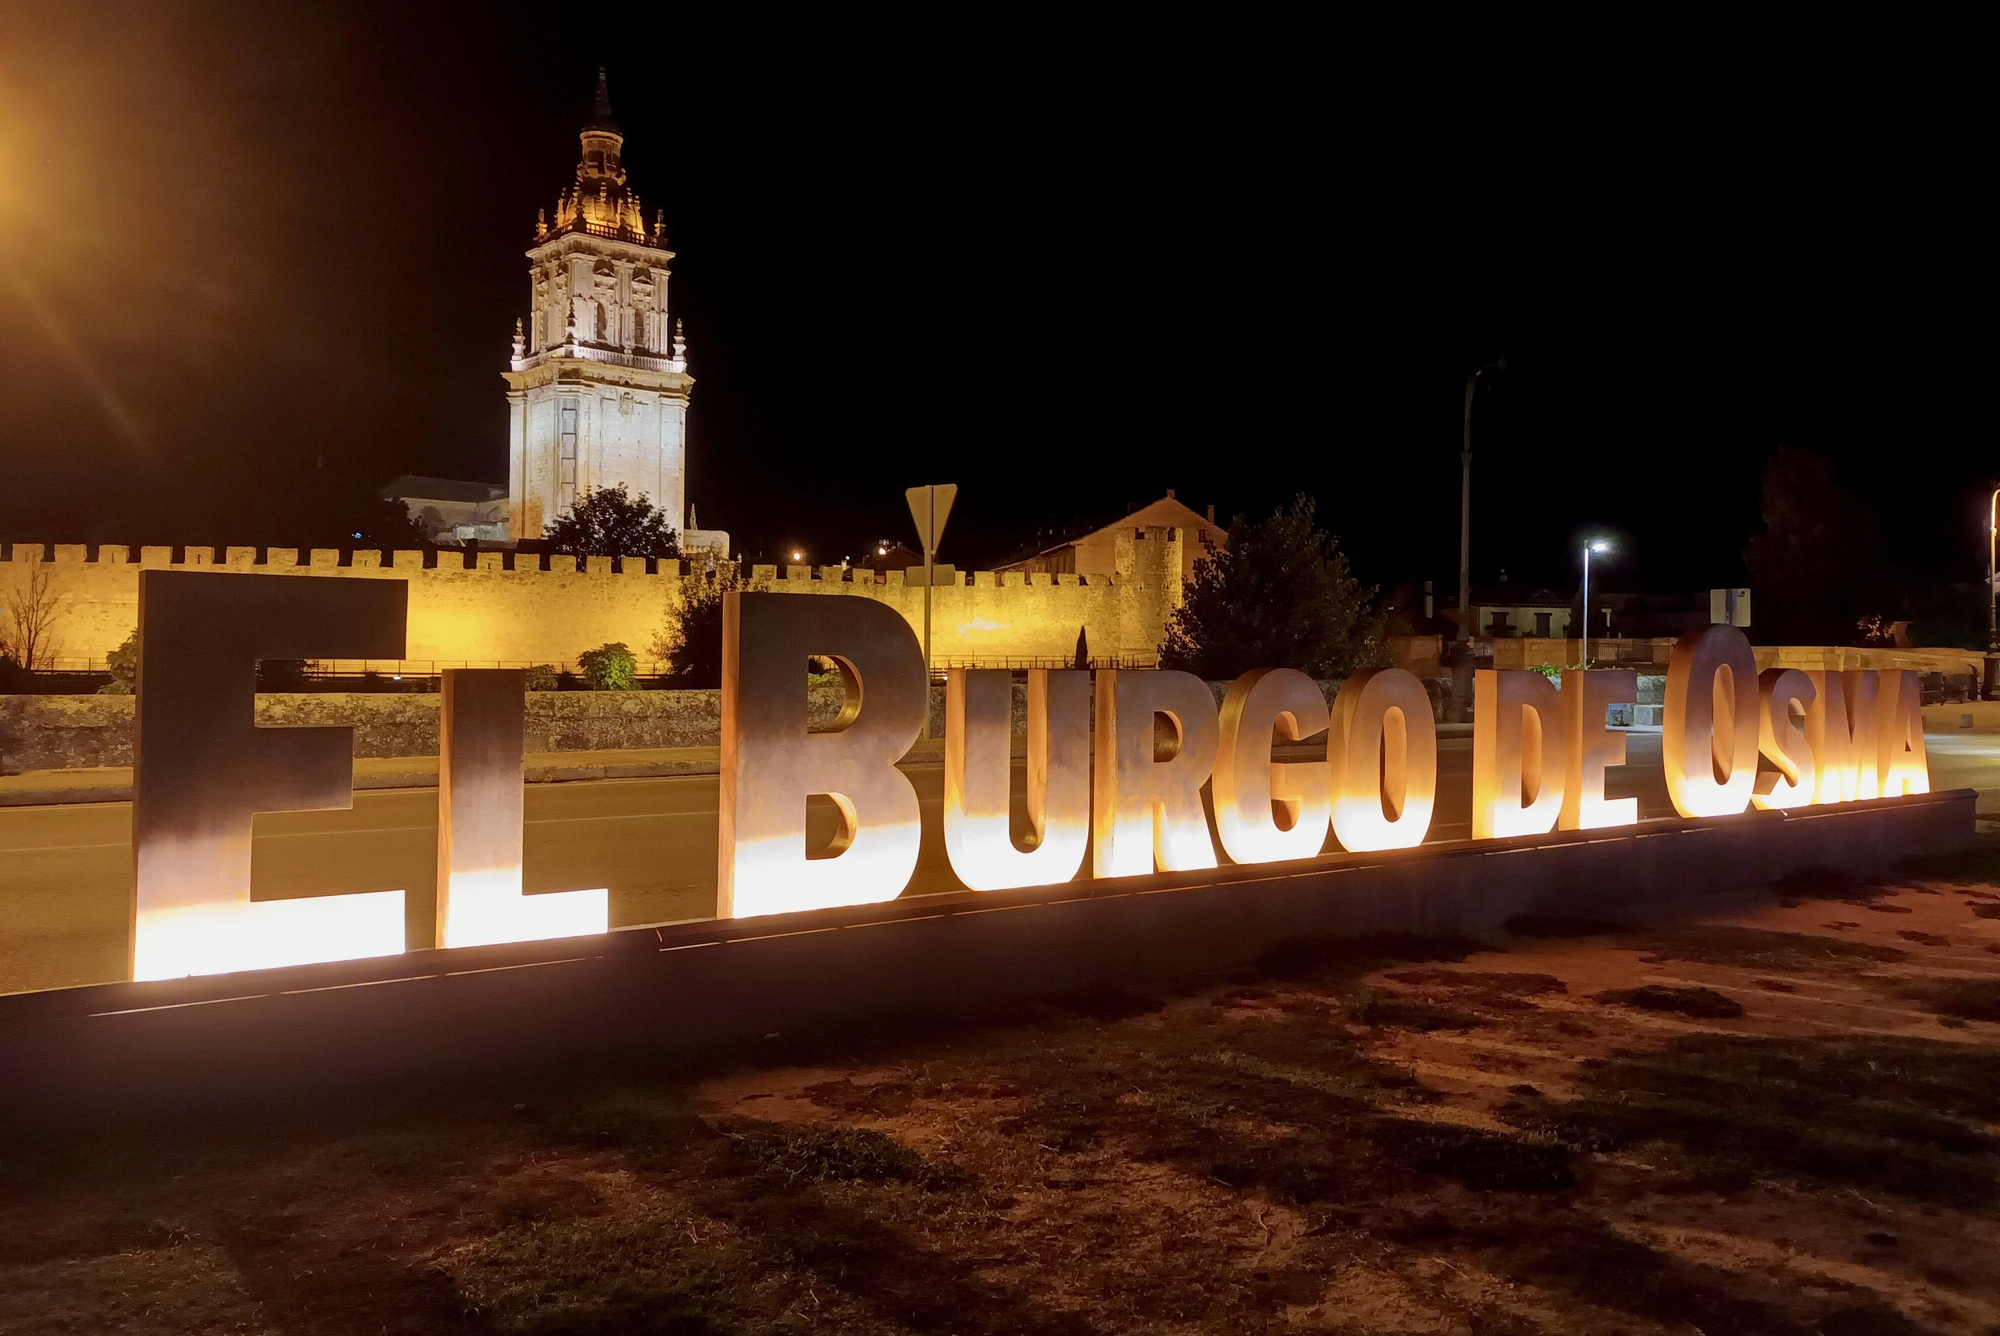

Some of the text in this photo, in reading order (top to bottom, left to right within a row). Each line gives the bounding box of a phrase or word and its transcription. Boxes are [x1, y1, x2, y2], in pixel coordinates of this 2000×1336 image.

[129, 569, 1931, 983] EL BURGO DE OSMA
